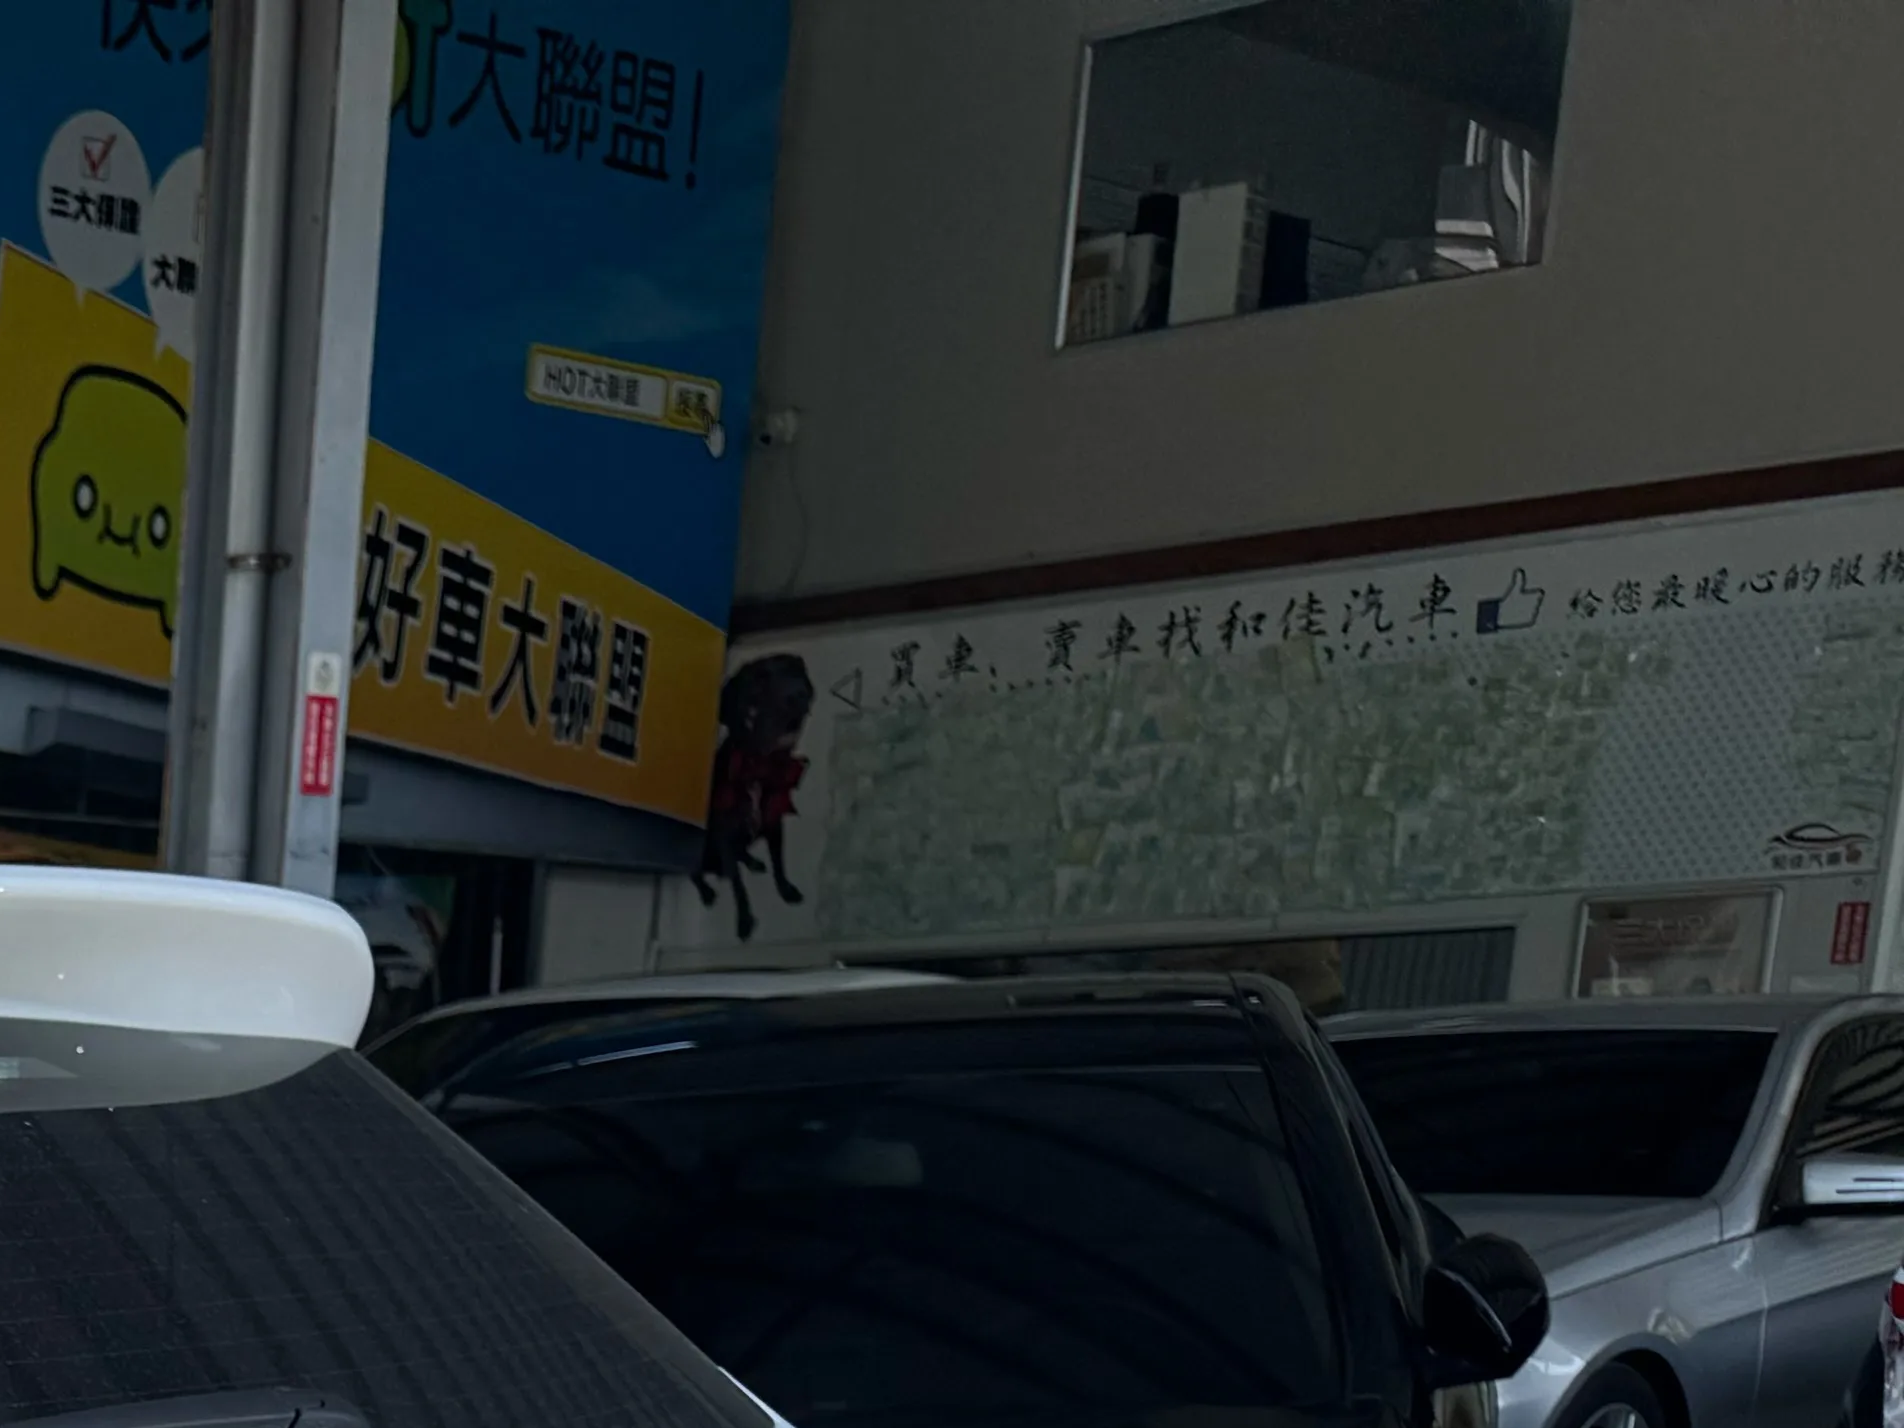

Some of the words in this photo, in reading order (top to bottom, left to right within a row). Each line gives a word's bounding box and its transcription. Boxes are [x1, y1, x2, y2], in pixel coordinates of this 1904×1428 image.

[352, 508, 648, 762] 好車大聯盟
